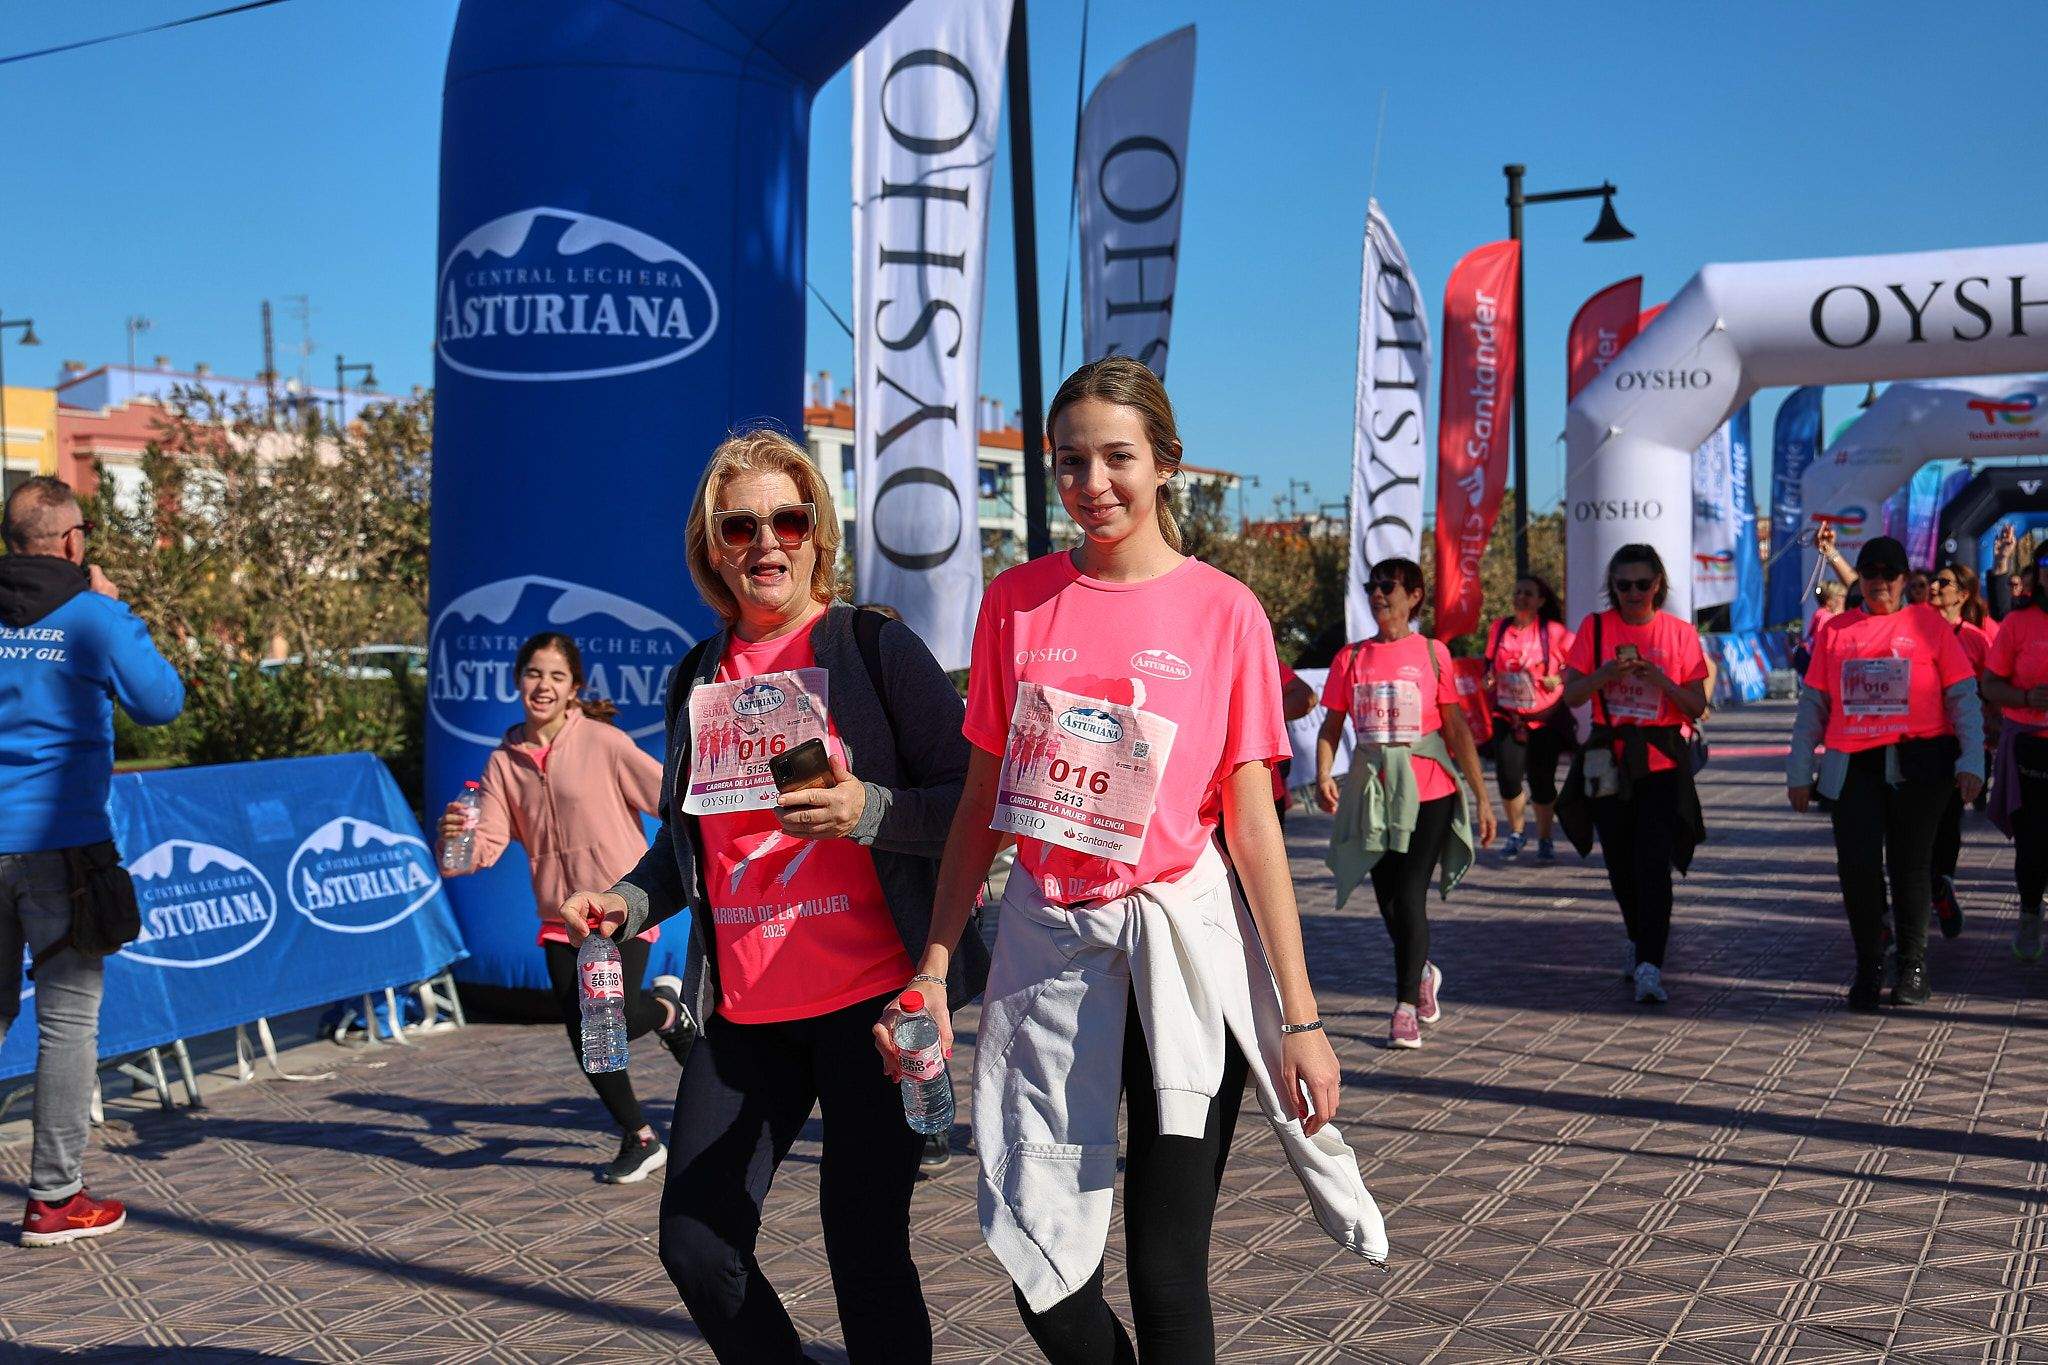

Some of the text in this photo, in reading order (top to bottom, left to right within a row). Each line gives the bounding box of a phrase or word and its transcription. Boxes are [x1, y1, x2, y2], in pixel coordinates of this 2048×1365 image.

[465, 267, 683, 288] CENTRAL LECHERA
[442, 279, 694, 341] ASTURIANA
[872, 47, 979, 572] OYSHO
[1810, 274, 2048, 349] OYSH
[1465, 288, 1497, 460] Santander
[1615, 368, 1712, 392] OYSHO
[1575, 500, 1663, 522] OYSHO
[35, 647, 67, 662] GIL
[457, 635, 673, 656] CENTR ECHERA
[1016, 648, 1077, 665] OYSHO
[1864, 682, 1890, 693] 016
[702, 708, 729, 719] SUMA
[738, 695, 782, 711] ASTURIANA
[1025, 711, 1051, 724] SUMA
[1062, 715, 1119, 740] ASTURIANA
[738, 733, 787, 761] 016
[746, 763, 770, 776] 5152
[1049, 758, 1111, 795] 016
[706, 781, 734, 791] CARRERA
[735, 780, 743, 788] DE
[745, 778, 753, 786] LA
[701, 794, 744, 808] OYSHO
[1054, 790, 1084, 808] 5413
[1004, 811, 1046, 830] OYSHO
[1009, 795, 1126, 832] CARRERA DE LA MUJER VALENCIA
[1076, 832, 1123, 852] Santander
[302, 861, 433, 911] ASTURIANA
[138, 890, 269, 943] STURIANA
[713, 894, 850, 924] ARRERA DE LA MUJER
[761, 923, 787, 939] 2025
[591, 972, 619, 981] ZERO
